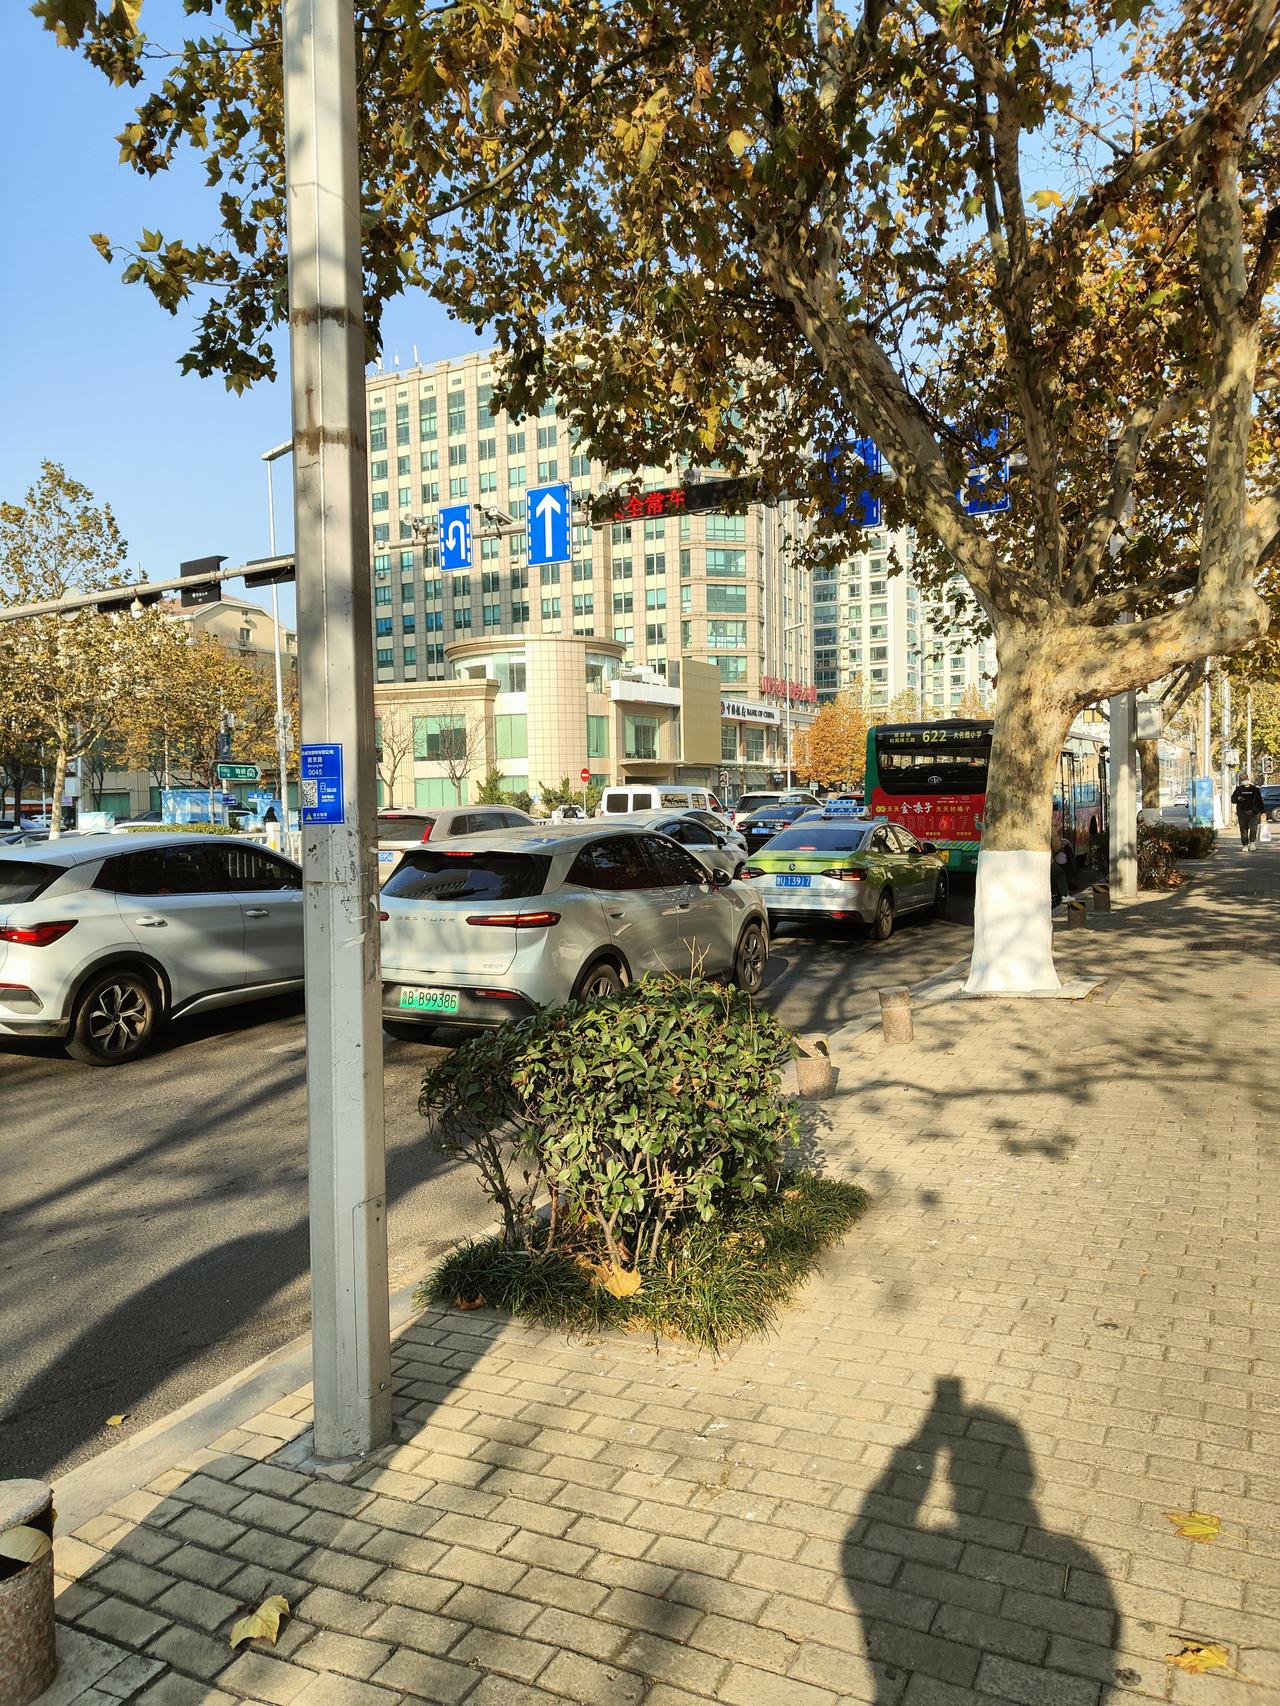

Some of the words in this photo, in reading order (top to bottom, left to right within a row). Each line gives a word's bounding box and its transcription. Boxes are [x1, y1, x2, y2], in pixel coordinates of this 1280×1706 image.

[922, 730, 947, 743] 622
[900, 801, 933, 814] 金嗓子
[935, 805, 971, 813] 天天好嗓子
